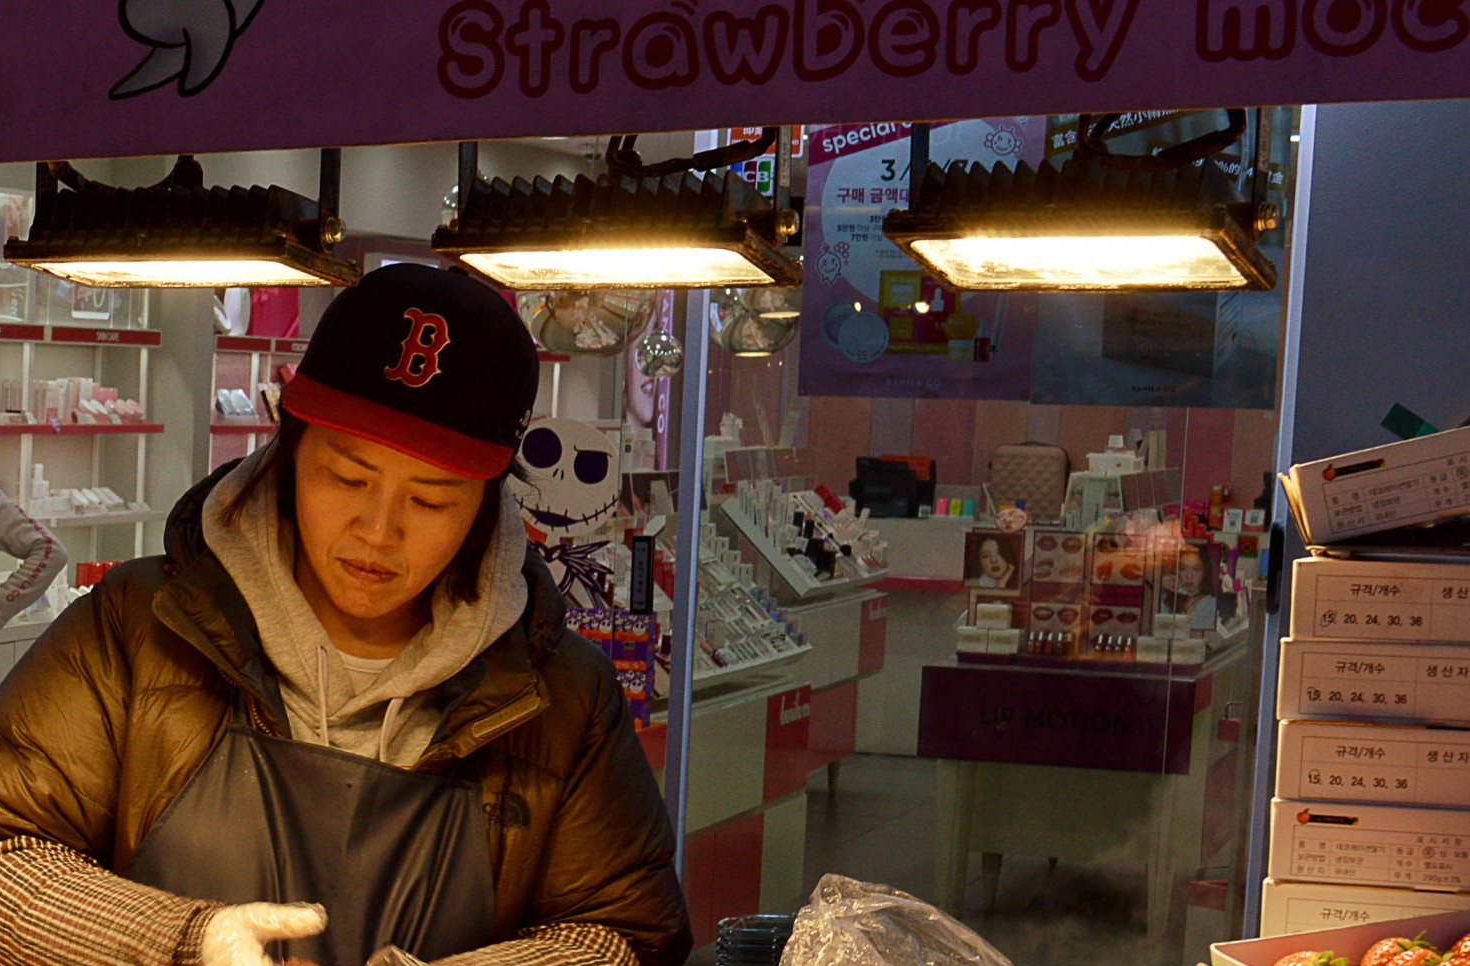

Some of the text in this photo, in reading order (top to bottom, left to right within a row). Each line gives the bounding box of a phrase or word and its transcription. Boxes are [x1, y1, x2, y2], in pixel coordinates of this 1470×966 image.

[836, 188, 865, 204] 구매
[384, 307, 450, 388] B
[1350, 583, 1400, 598] 규격/개수
[1409, 616, 1423, 627] 36
[1335, 661, 1385, 675] 규격/개수
[1394, 694, 1408, 704] 36
[1335, 745, 1386, 759] 규격/개수
[1395, 778, 1408, 789] 36
[1320, 908, 1370, 922] 규격/개수
